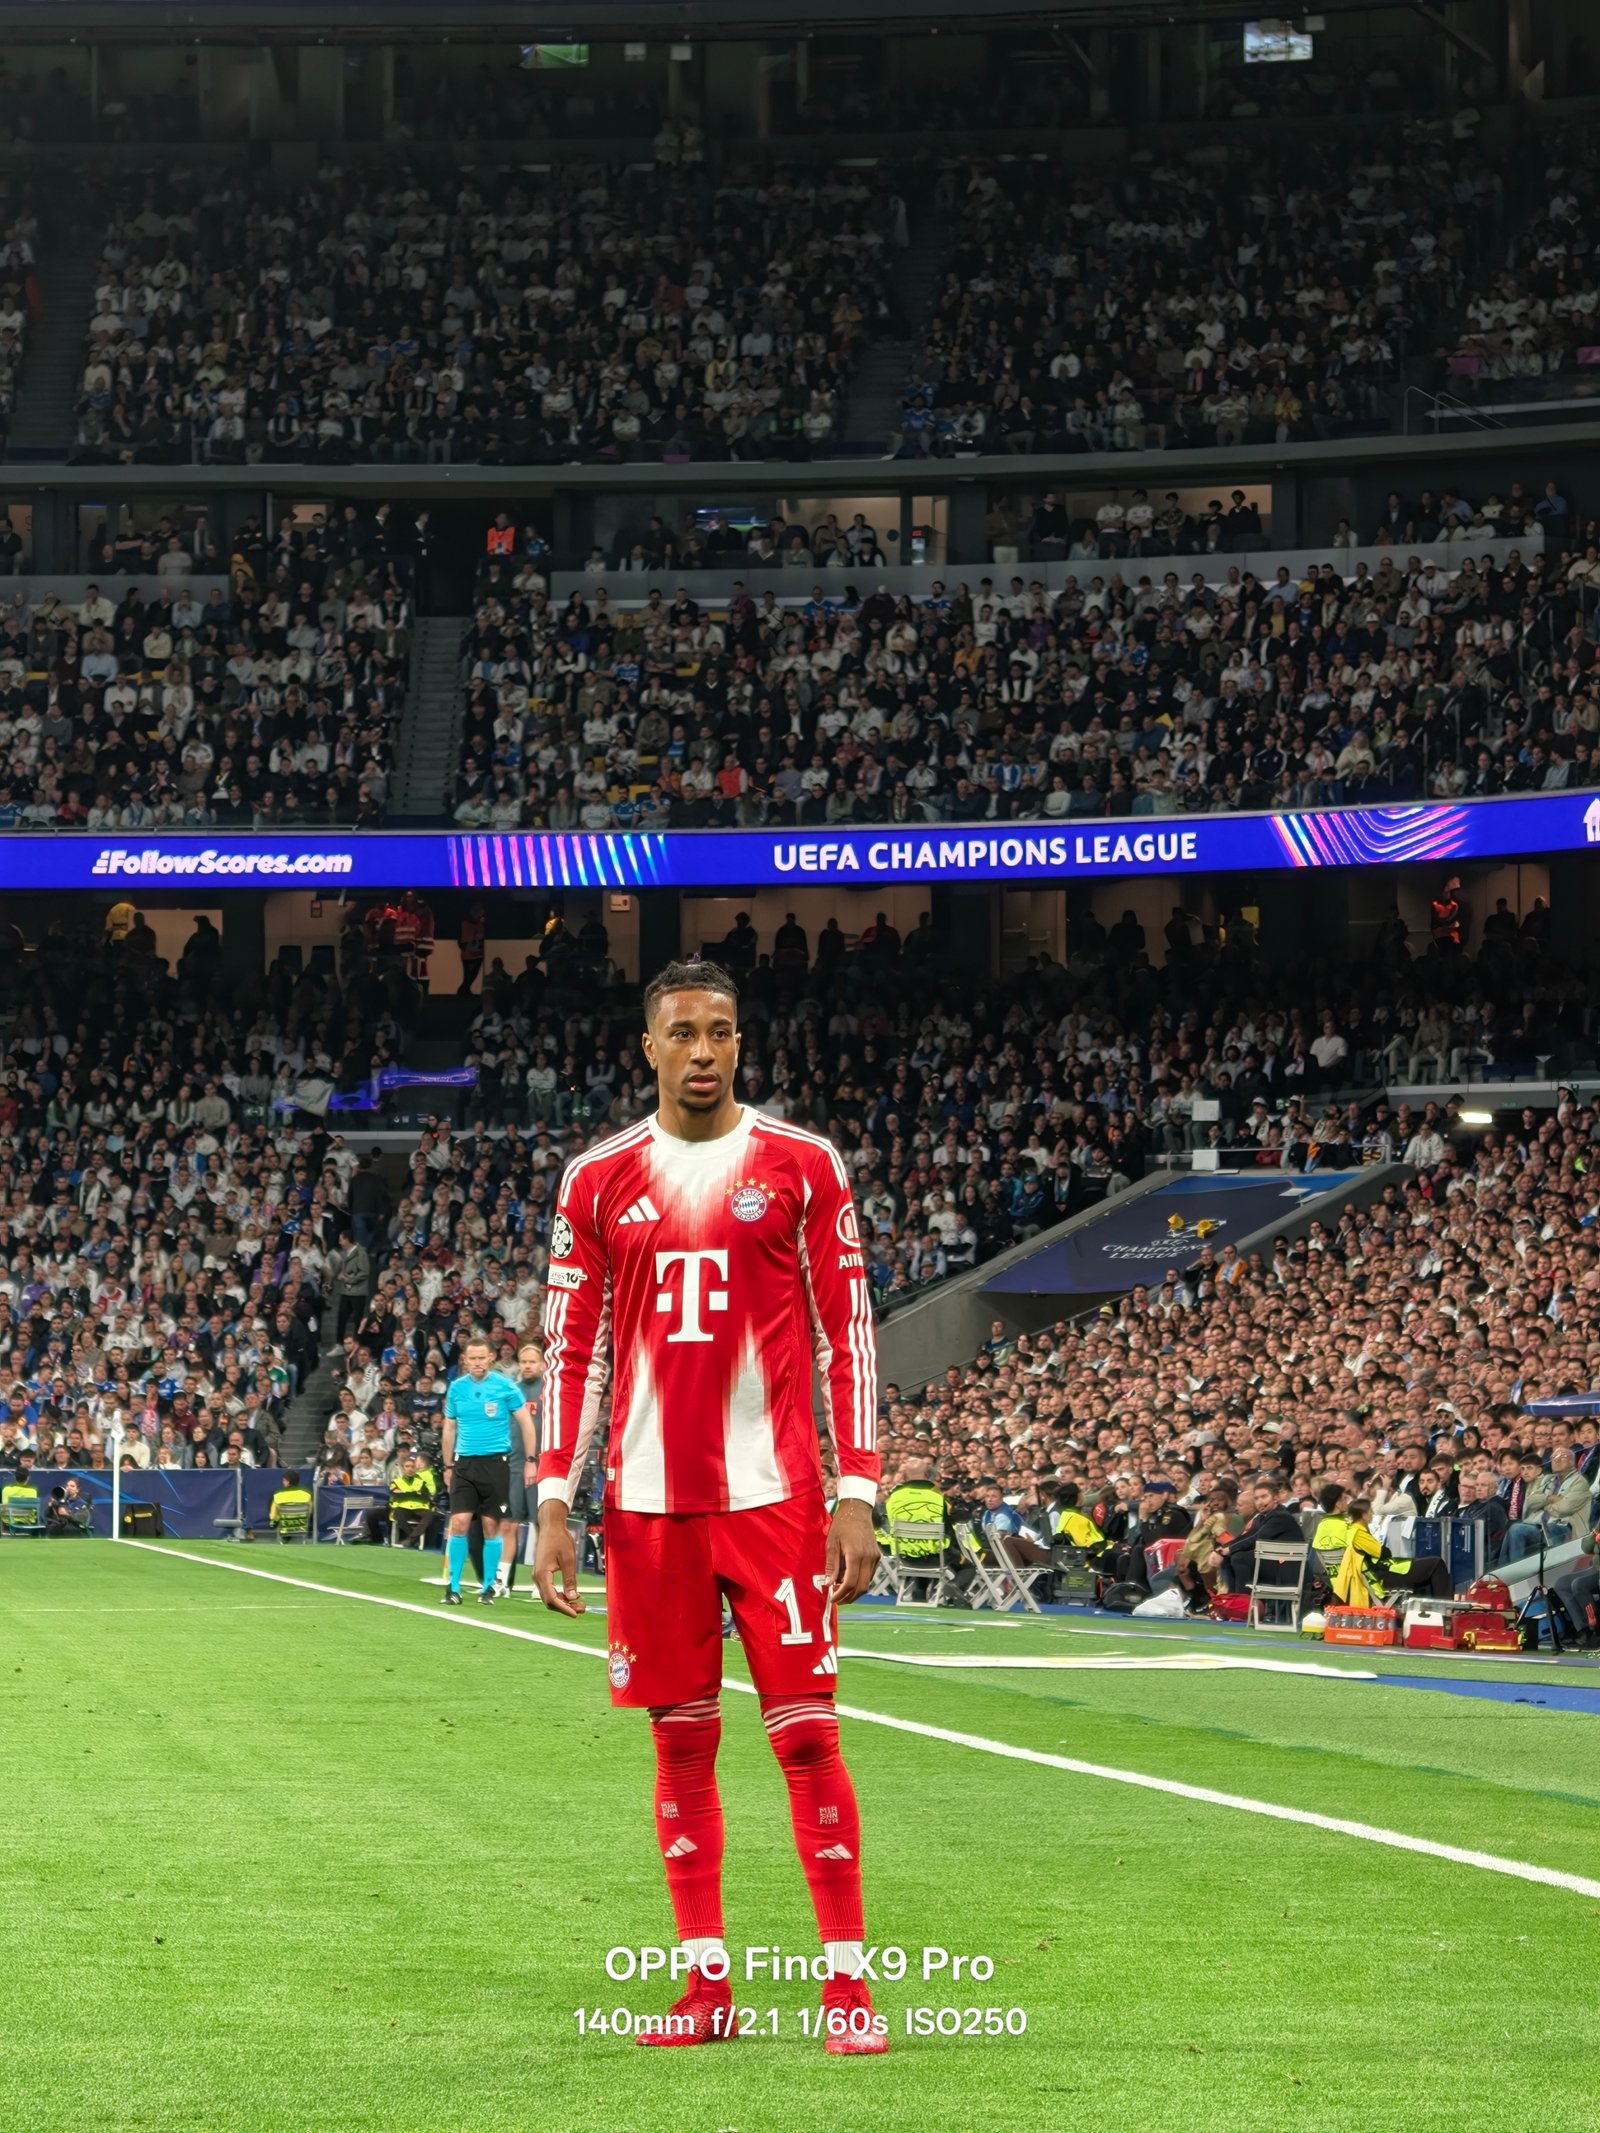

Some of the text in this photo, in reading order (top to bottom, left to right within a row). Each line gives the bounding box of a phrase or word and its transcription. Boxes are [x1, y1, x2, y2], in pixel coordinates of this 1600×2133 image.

[93, 850, 353, 874] FollowScores.com
[774, 833, 1198, 871] UEFA CHAMPIONS LEAGUE
